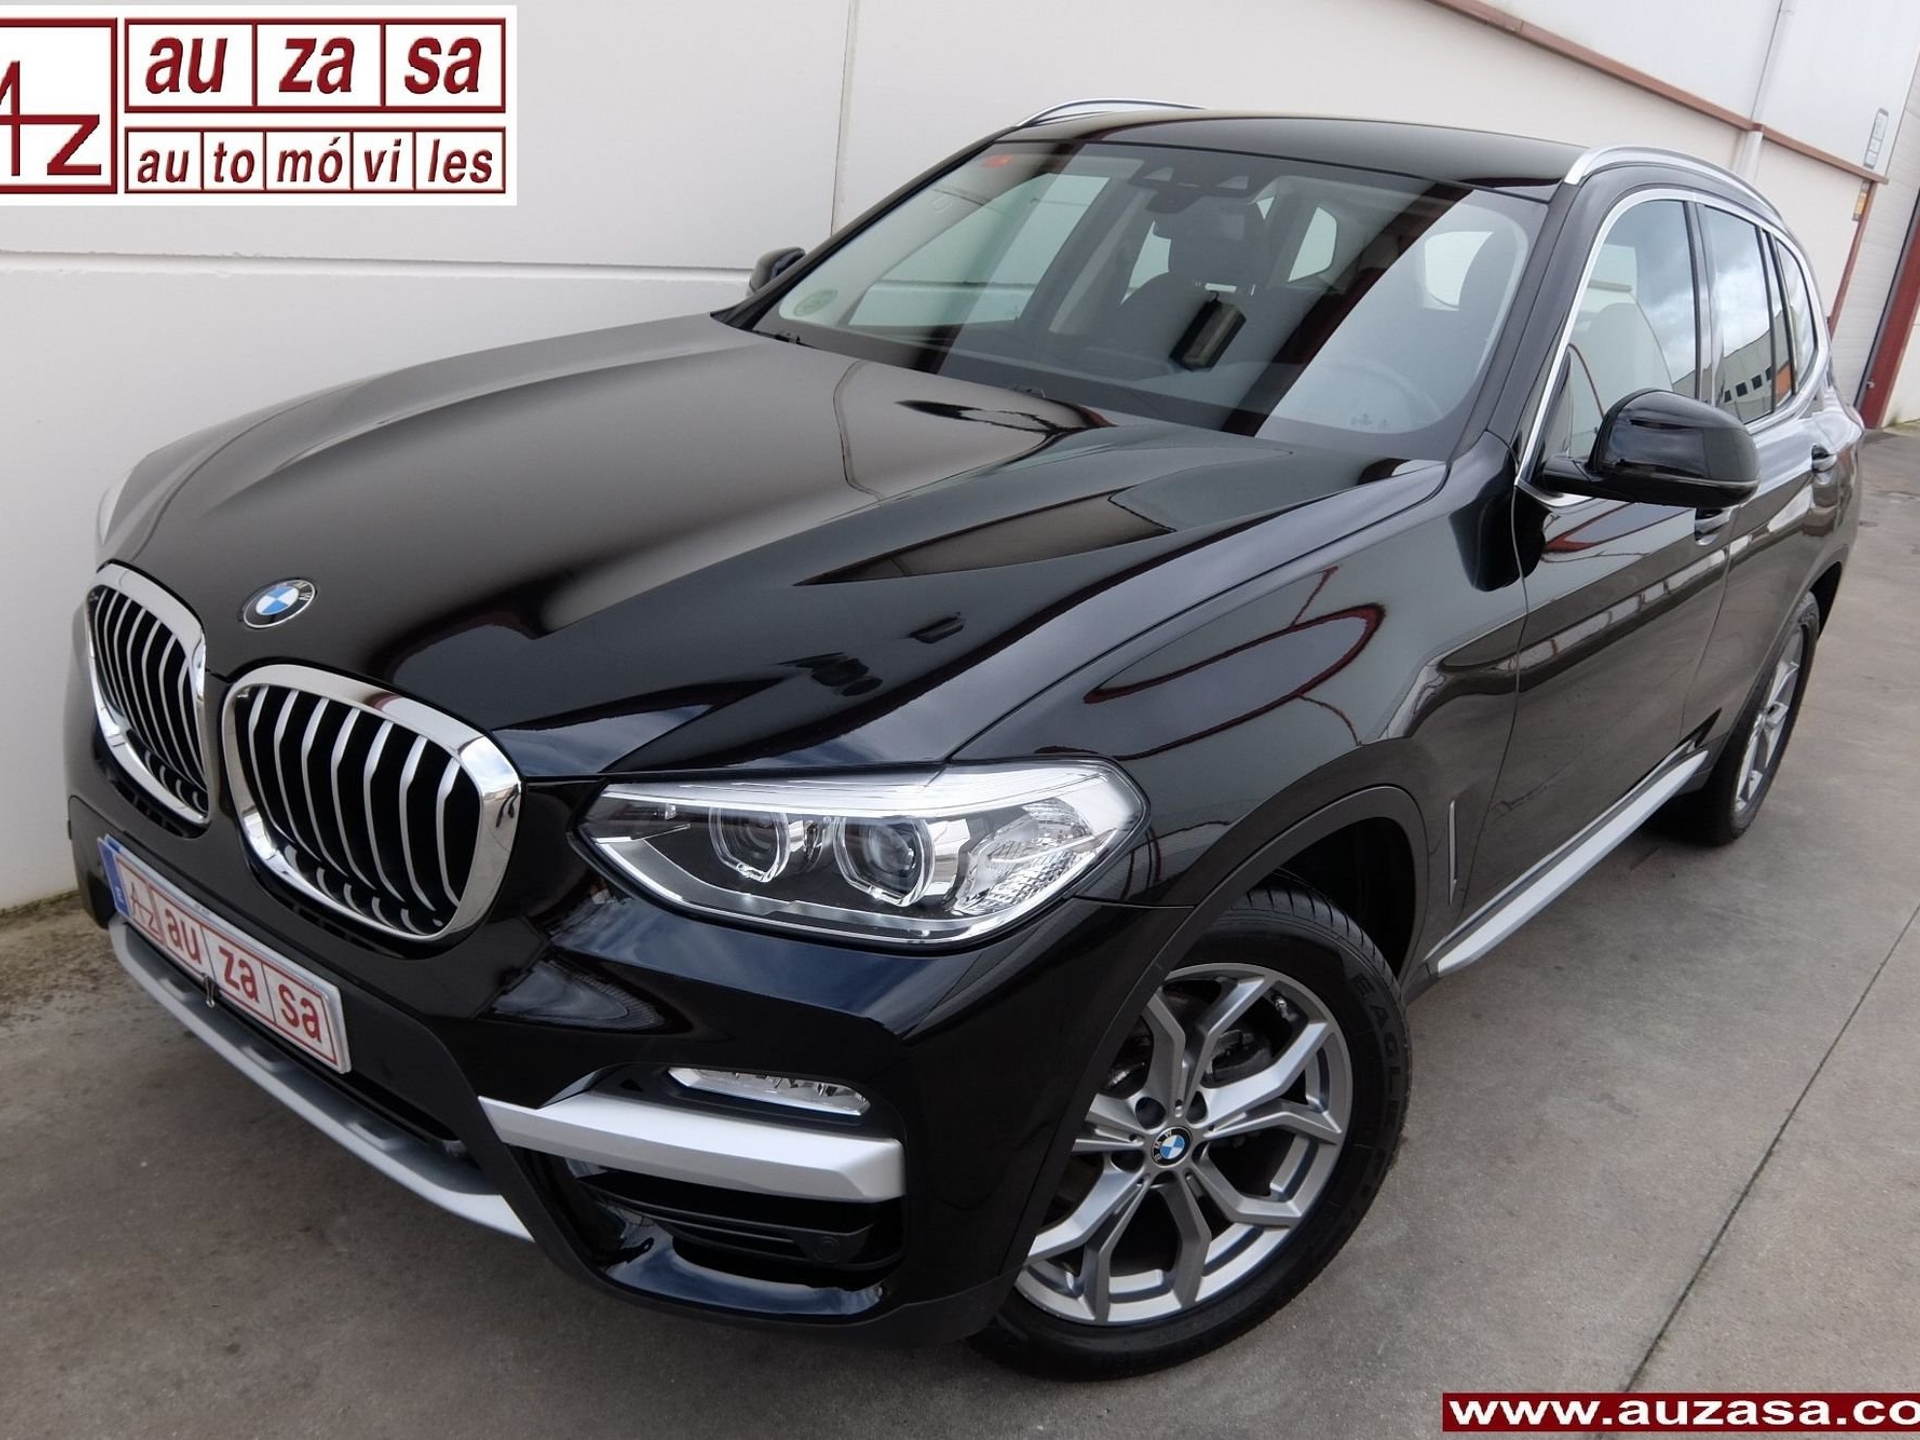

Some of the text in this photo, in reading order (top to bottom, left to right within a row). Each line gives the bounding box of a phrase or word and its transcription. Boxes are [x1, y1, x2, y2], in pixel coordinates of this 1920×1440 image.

[165, 908, 203, 965] au
[218, 945, 261, 1004] za
[278, 983, 322, 1044] sa
[1352, 972, 1401, 1131] EAGLE
